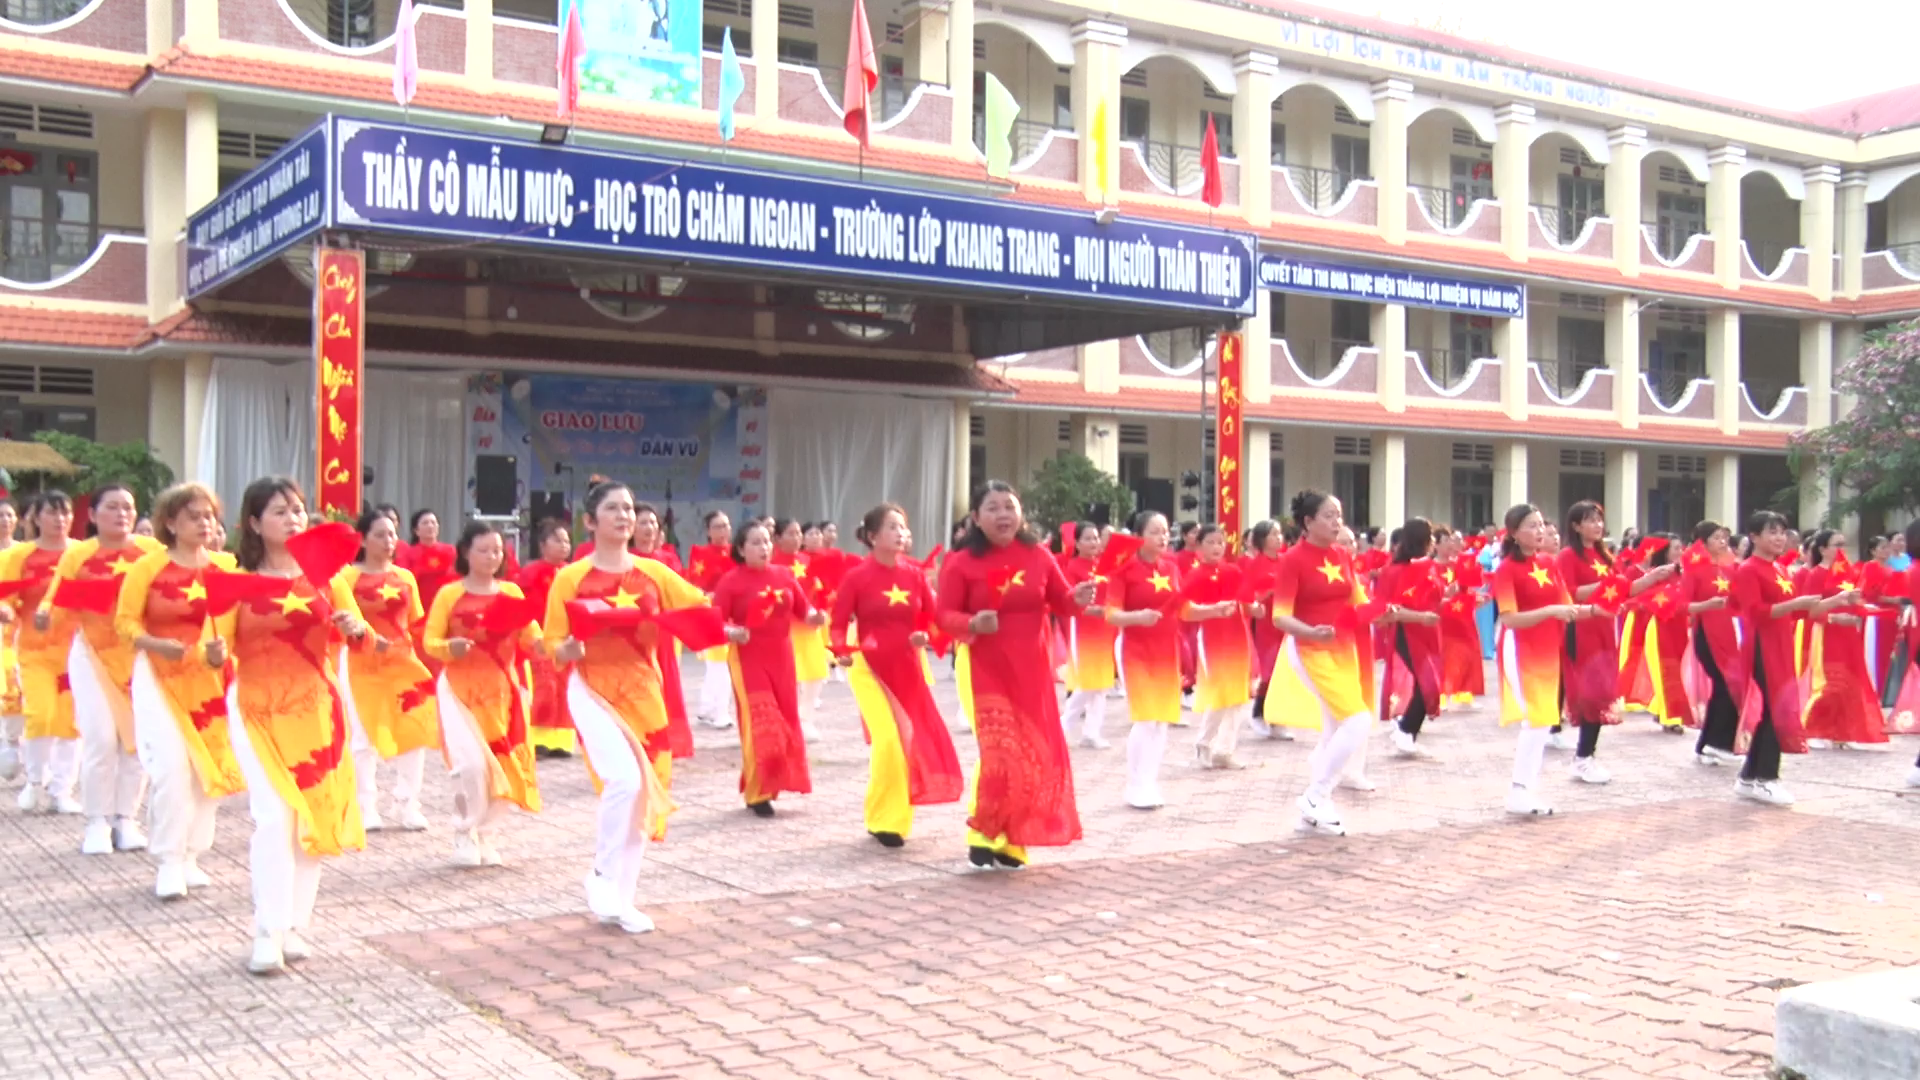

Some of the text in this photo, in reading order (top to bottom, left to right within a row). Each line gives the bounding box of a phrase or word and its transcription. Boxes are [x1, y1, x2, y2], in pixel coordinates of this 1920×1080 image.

[362, 136, 423, 212] THẦY
[428, 149, 460, 216] CÔ
[466, 145, 518, 222] MẪU
[524, 168, 574, 238] MỰC
[594, 177, 637, 244] HỌC
[642, 174, 681, 239] TRÒ
[686, 181, 745, 245] CHĂM
[750, 196, 816, 252] NGOAN
[832, 198, 904, 262] TRƯỜNG
[908, 207, 942, 265] LỚP
[946, 219, 1003, 272] KHANG
[1007, 227, 1060, 279] TRANG
[1074, 235, 1104, 292] MỌI
[1108, 233, 1155, 288] NGƯỜI
[1157, 239, 1197, 293] THÂN
[1199, 245, 1241, 307] THIỆN
[1292, 263, 1313, 286] TÂM
[1314, 268, 1329, 288] THI
[541, 409, 645, 432] GIAO LƯU
[640, 434, 675, 457] DÂN
